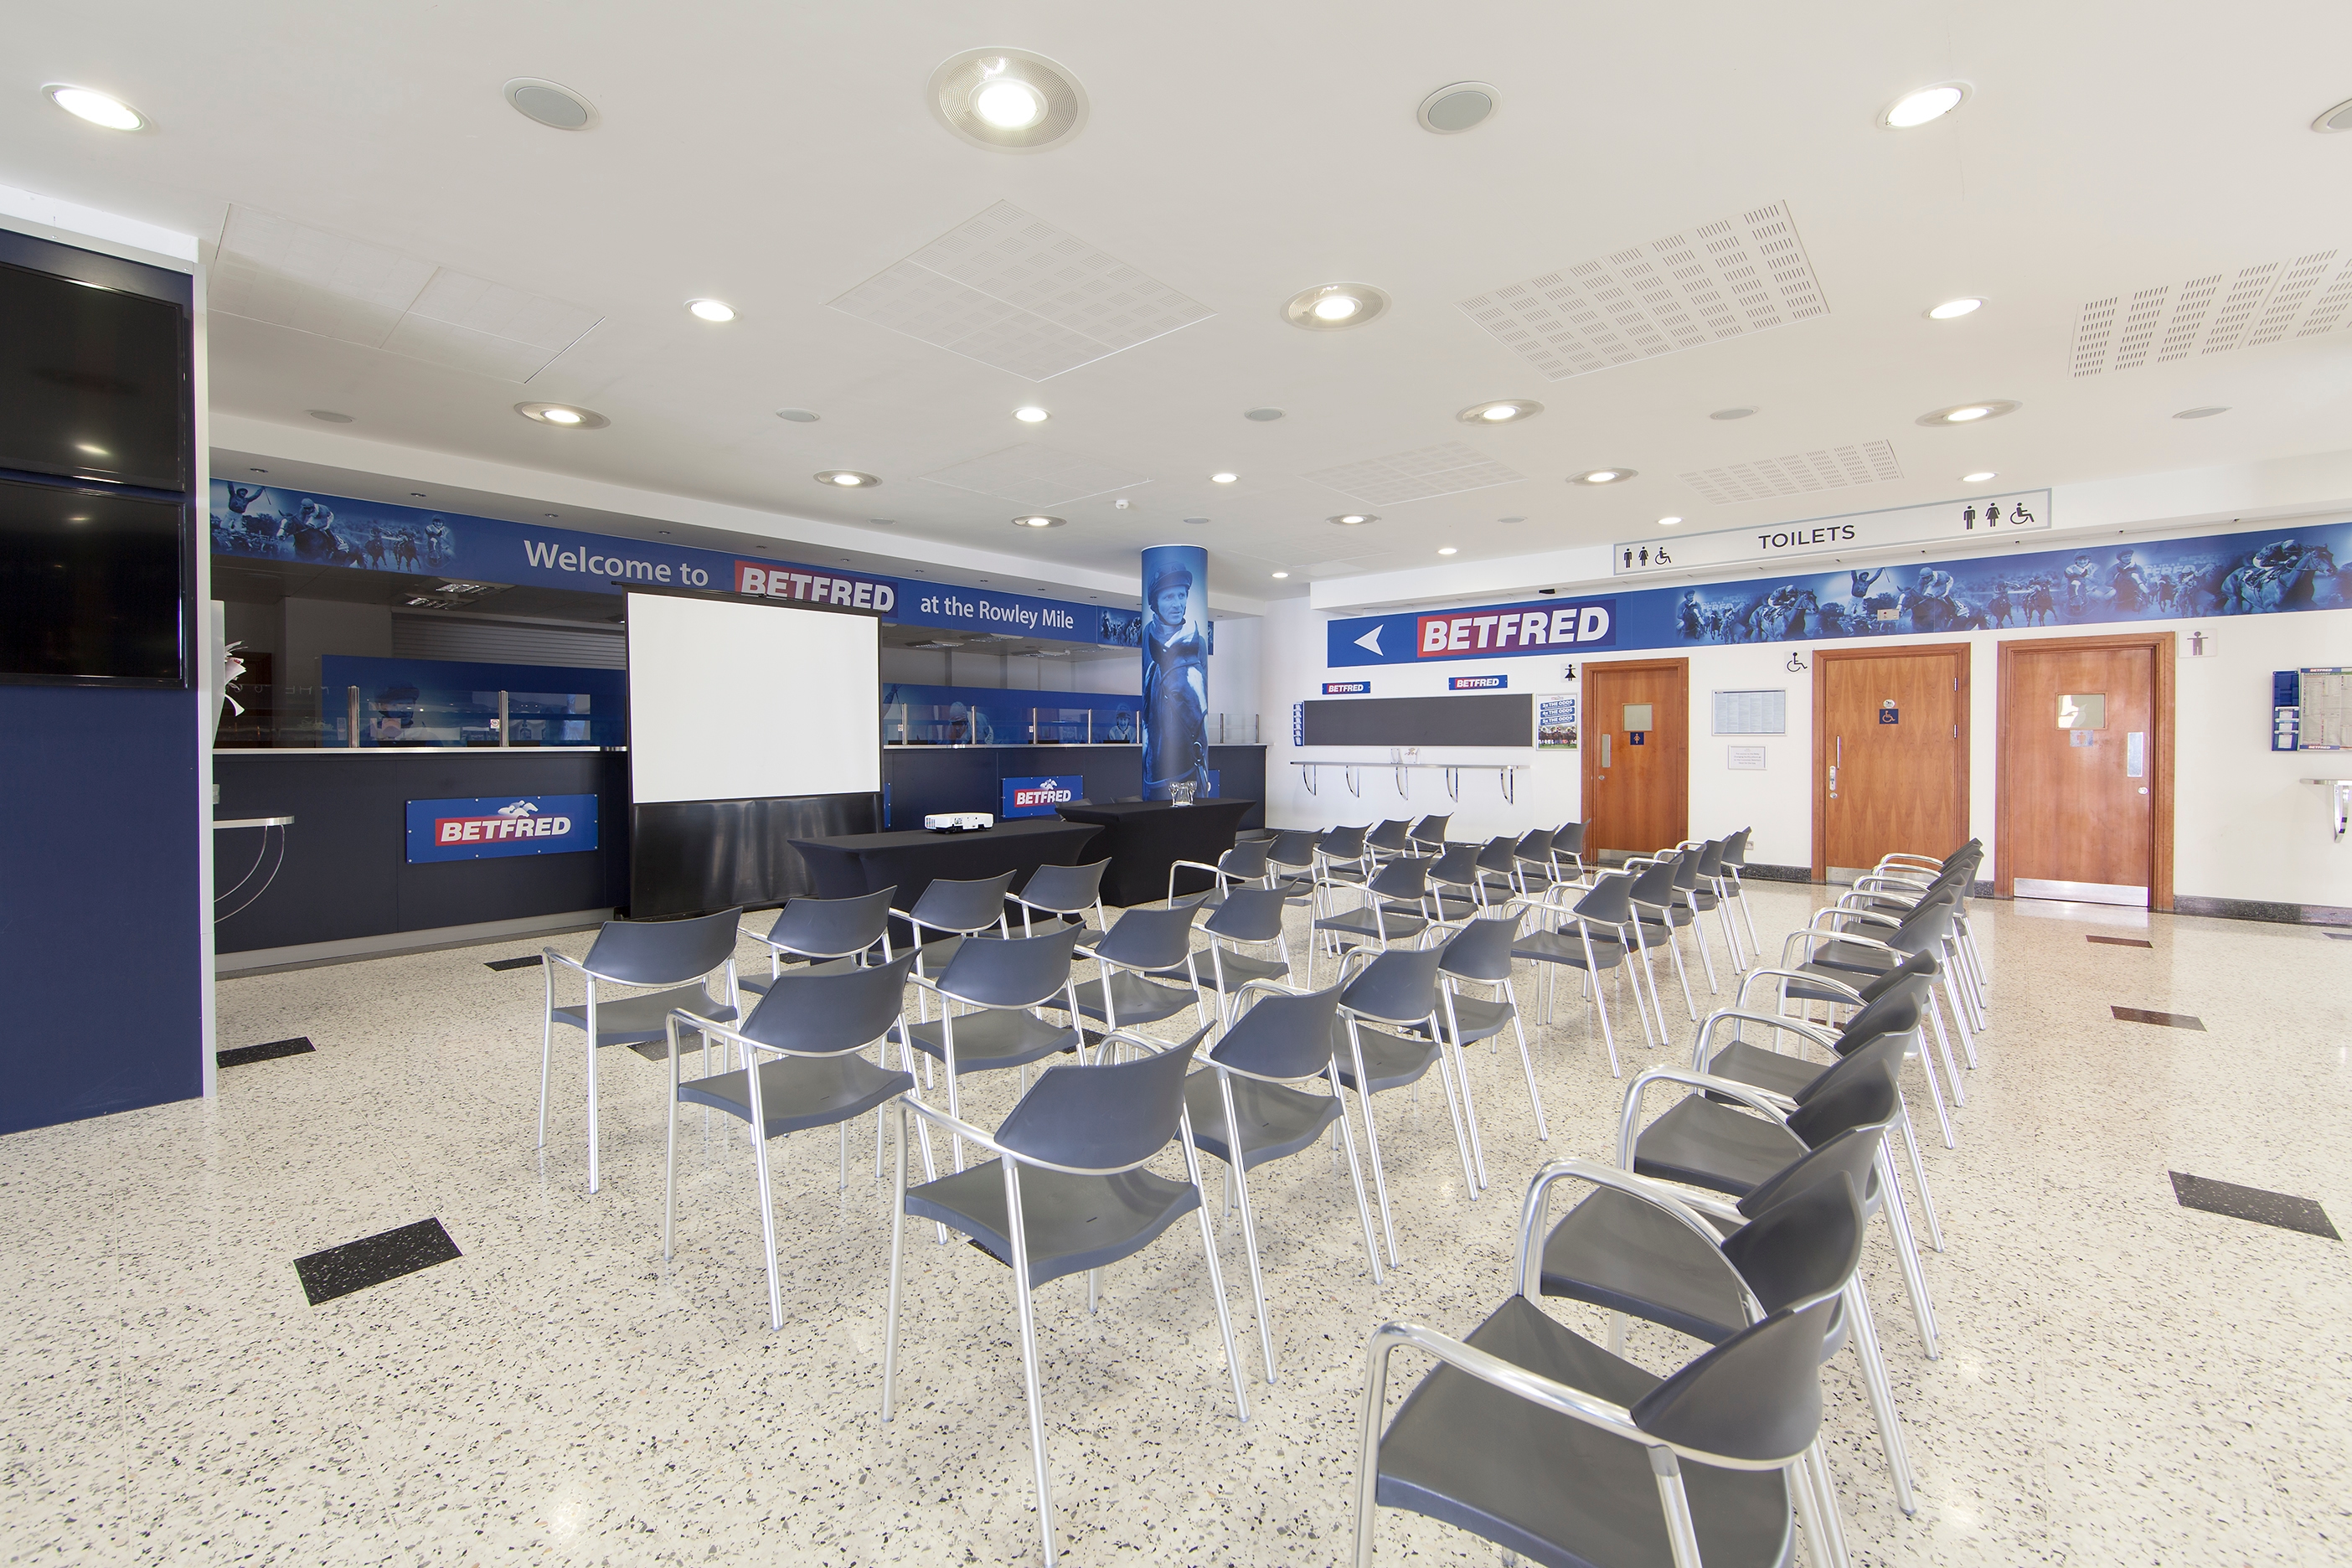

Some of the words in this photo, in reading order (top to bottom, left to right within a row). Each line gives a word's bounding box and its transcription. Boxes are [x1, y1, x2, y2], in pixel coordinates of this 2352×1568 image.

[1757, 524, 1855, 549] TOILETS
[524, 539, 672, 583] Welcome
[679, 563, 709, 586] to
[740, 566, 895, 611] BETFRED
[921, 596, 940, 614] at
[944, 596, 974, 618] the
[979, 601, 1039, 630] Rowley
[1042, 608, 1074, 629] Mile
[1422, 606, 1610, 652] BETFRED
[1328, 683, 1364, 693] BETFRED
[1457, 678, 1500, 688] BETFRED
[1016, 790, 1072, 806] BETFRED
[441, 817, 571, 843] BETFRED
